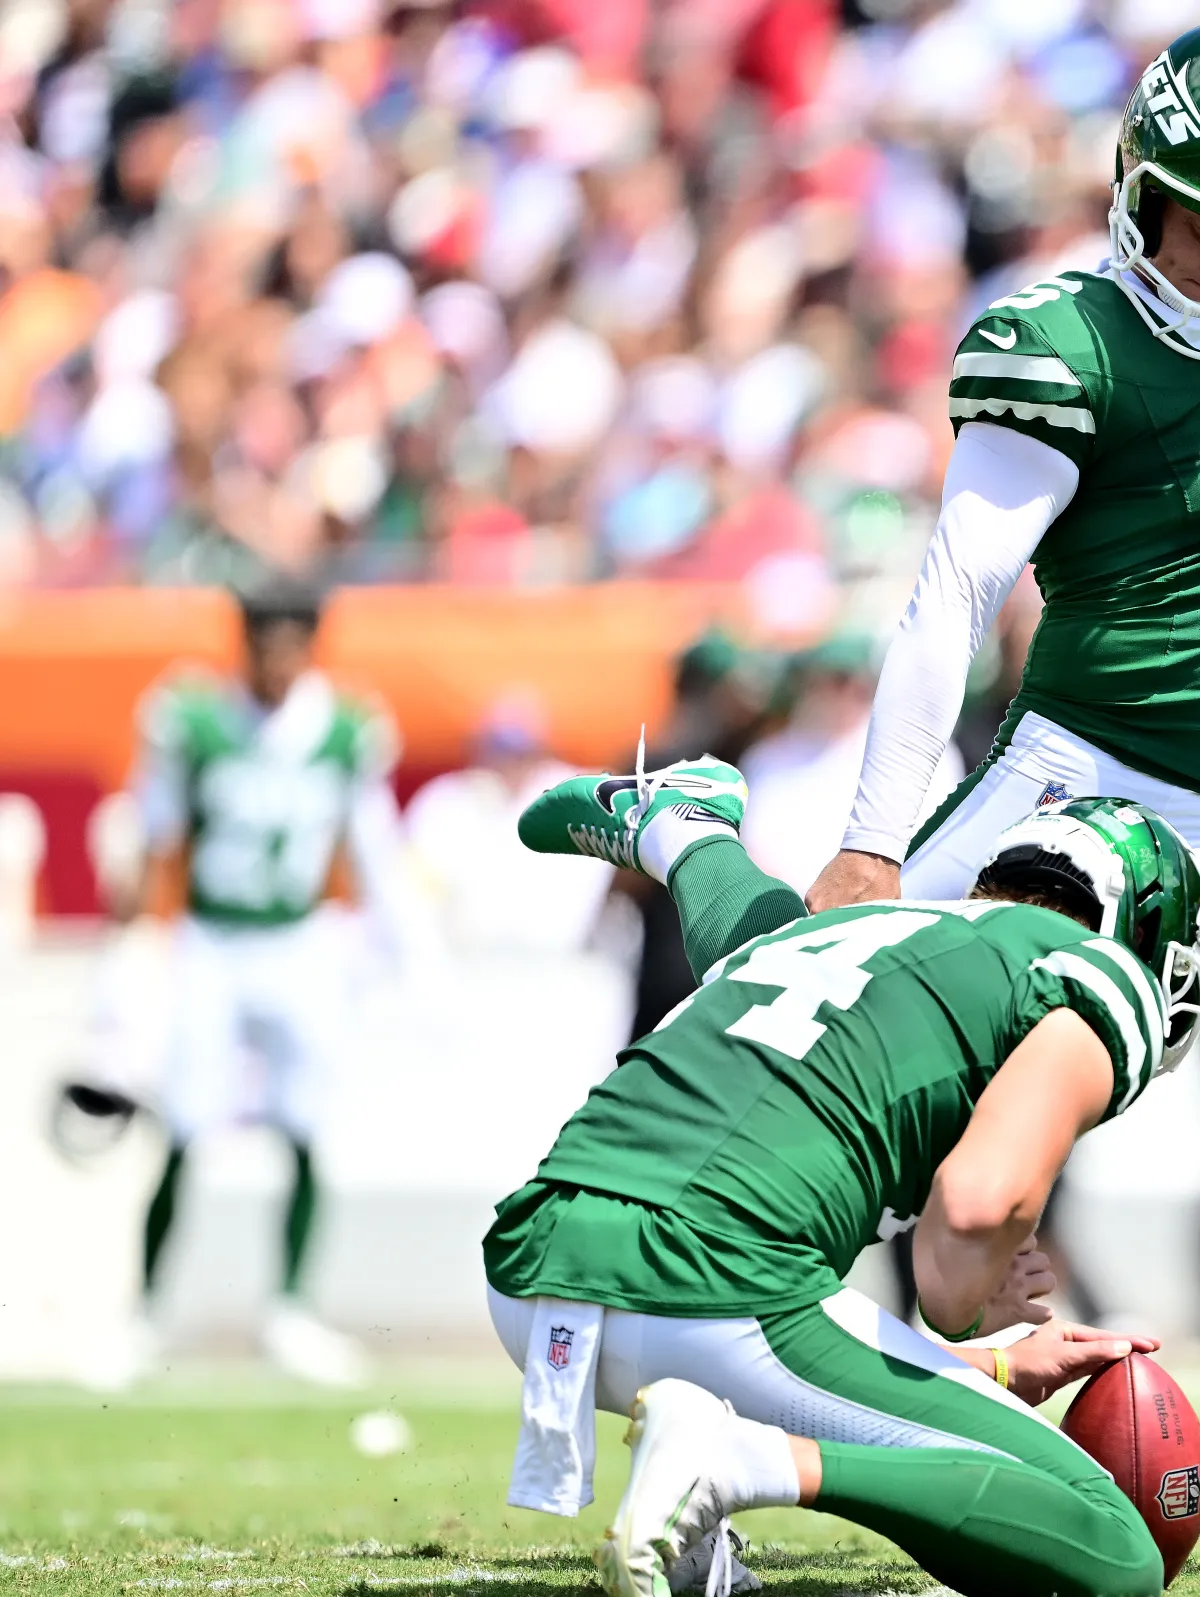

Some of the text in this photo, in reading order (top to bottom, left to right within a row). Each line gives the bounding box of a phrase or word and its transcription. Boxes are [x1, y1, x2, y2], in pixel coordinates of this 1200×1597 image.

[652, 908, 941, 1061] 4
[549, 1343, 568, 1366] NFL
[1153, 1394, 1169, 1439] Wilson
[1163, 1474, 1188, 1516] NFL
